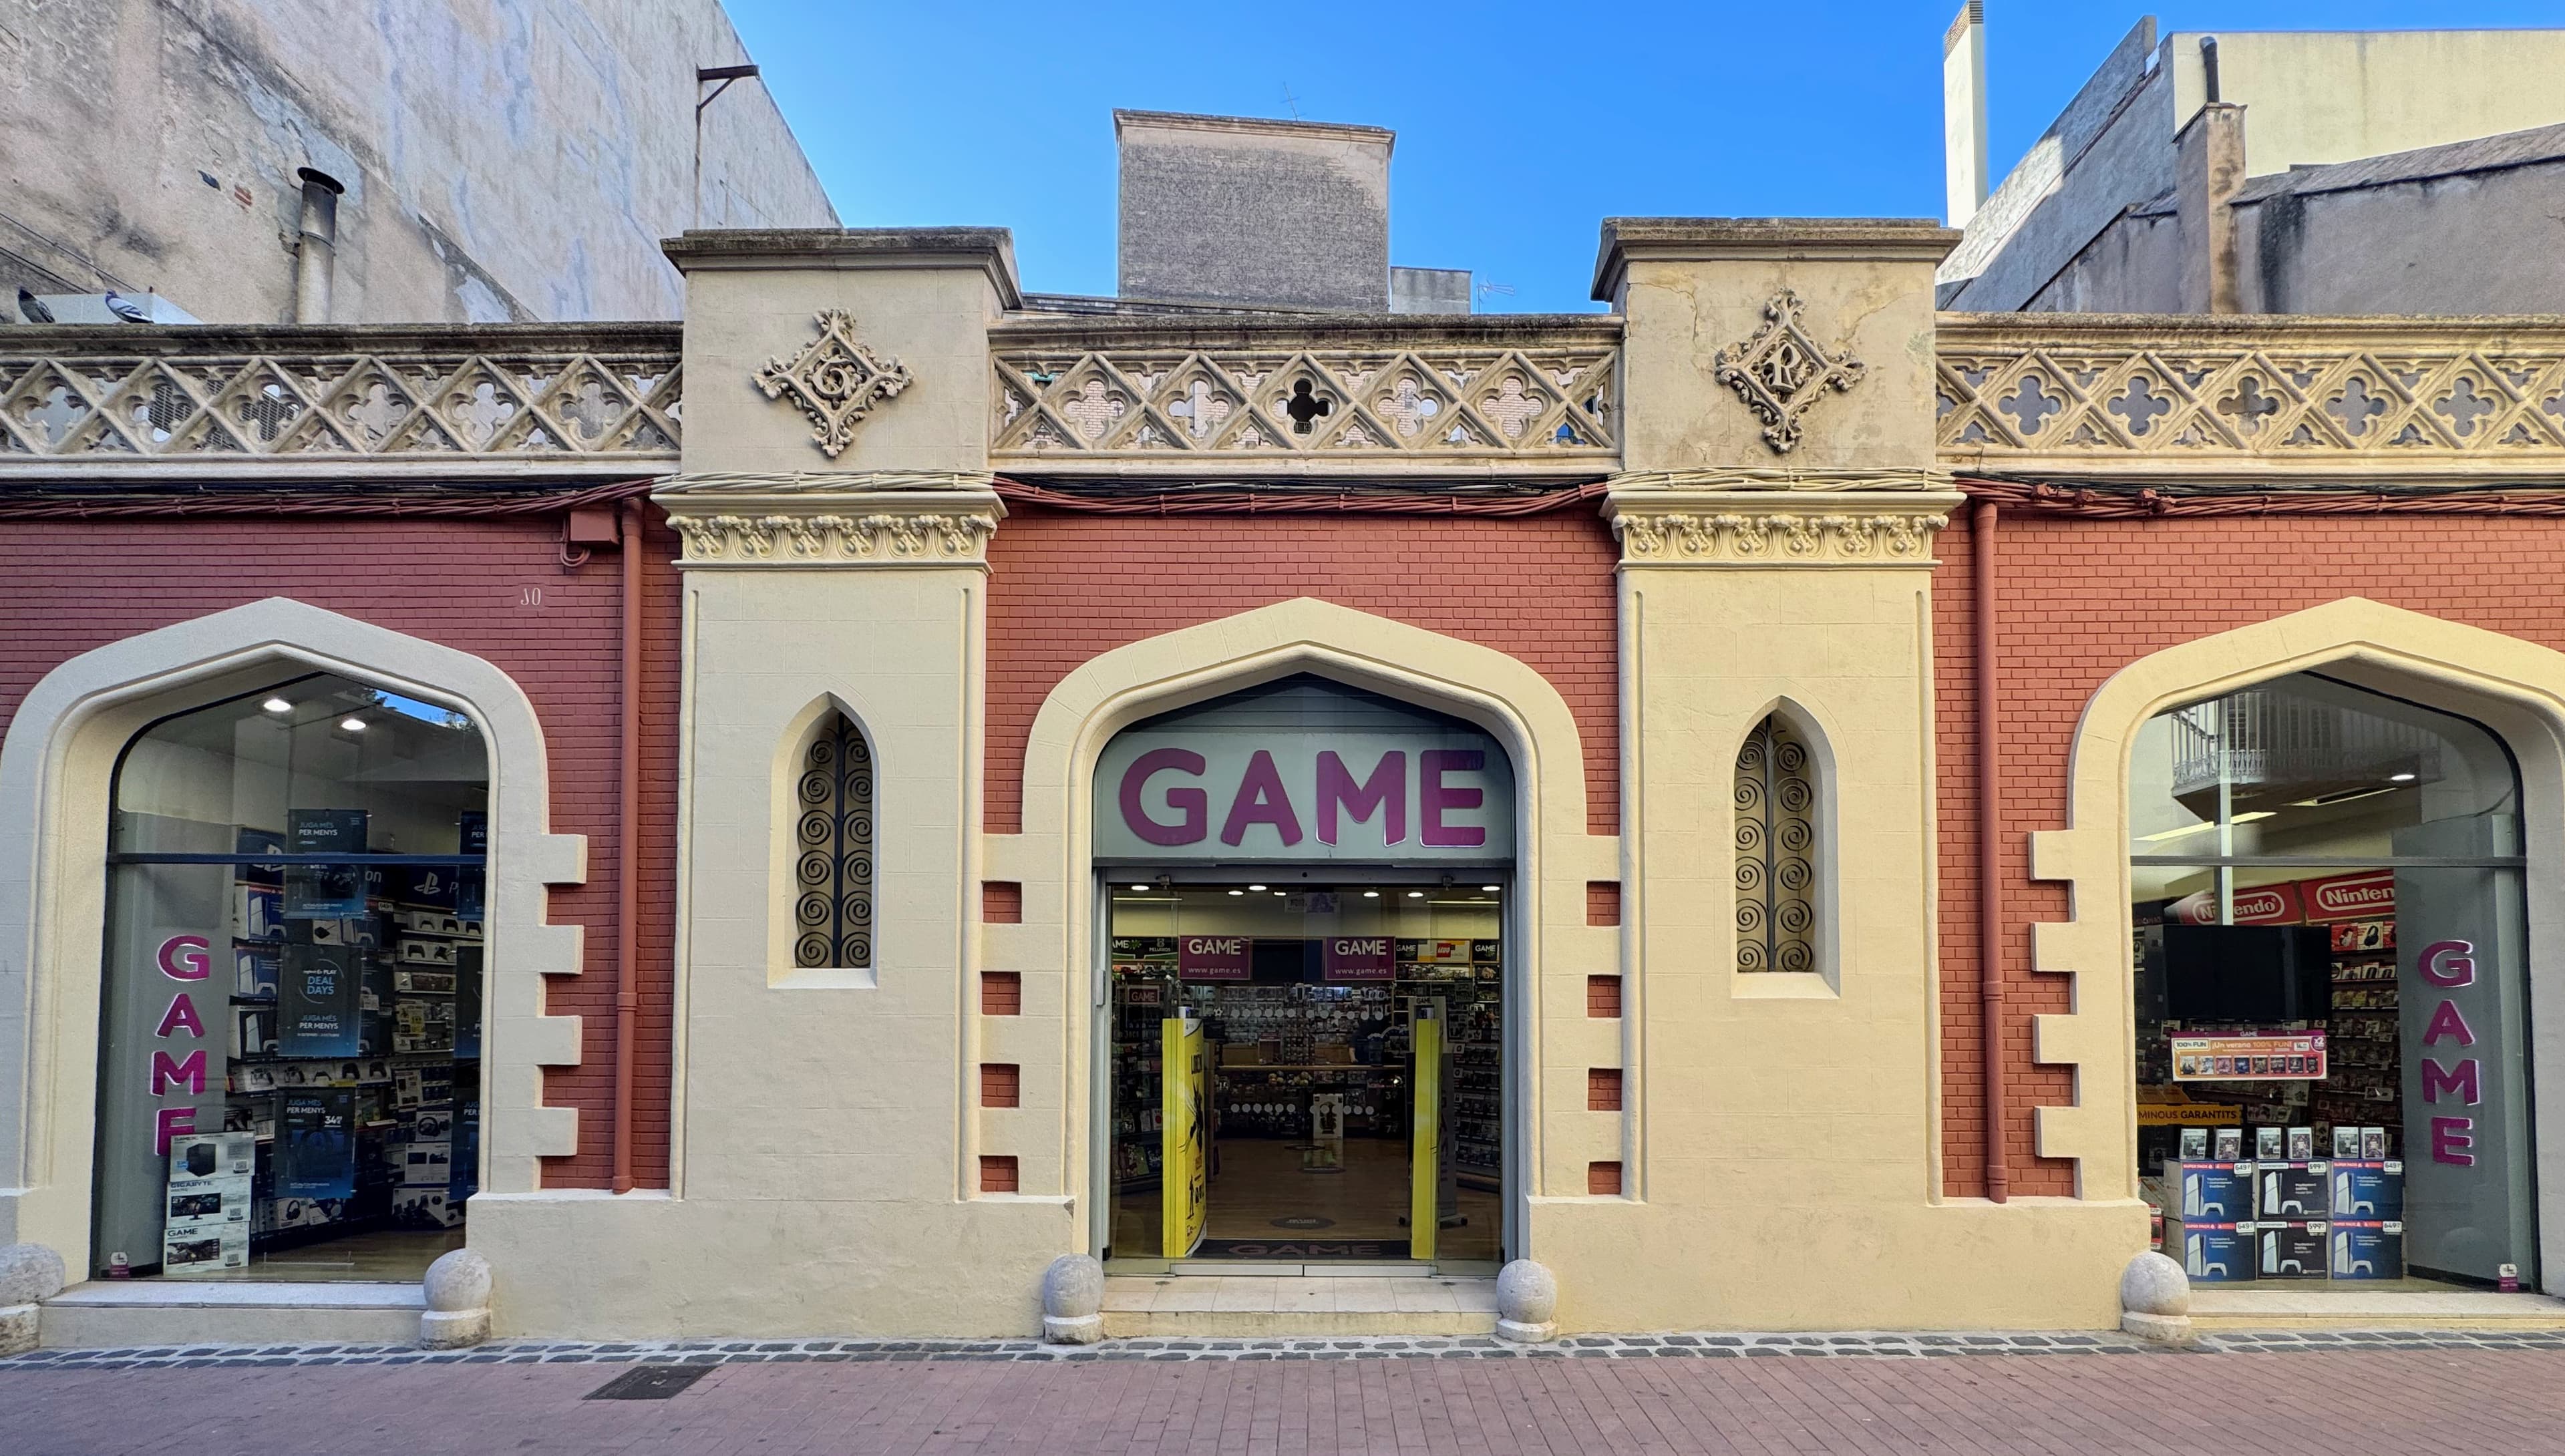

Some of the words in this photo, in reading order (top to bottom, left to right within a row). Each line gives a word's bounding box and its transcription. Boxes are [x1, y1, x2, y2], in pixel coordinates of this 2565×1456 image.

[1119, 747, 1486, 848] GAME
[2199, 899, 2276, 920] Niendo
[1188, 938, 1241, 954] GAME
[1335, 940, 1387, 956] GAME
[1475, 944, 1496, 952] GAME
[1188, 966, 1241, 975] www.game.es
[1335, 966, 1387, 976] www.game.es
[308, 976, 335, 985] DEAL
[307, 985, 334, 994] DAYS
[1132, 991, 1155, 1002] GAME
[151, 934, 210, 1157] GAME
[2418, 939, 2481, 1166] GAME
[2180, 1110, 2236, 1119] GARANTITS
[170, 1180, 213, 1188] GIGABYTE
[168, 1227, 198, 1237] GAME
[1228, 1243, 1381, 1256] GAME
